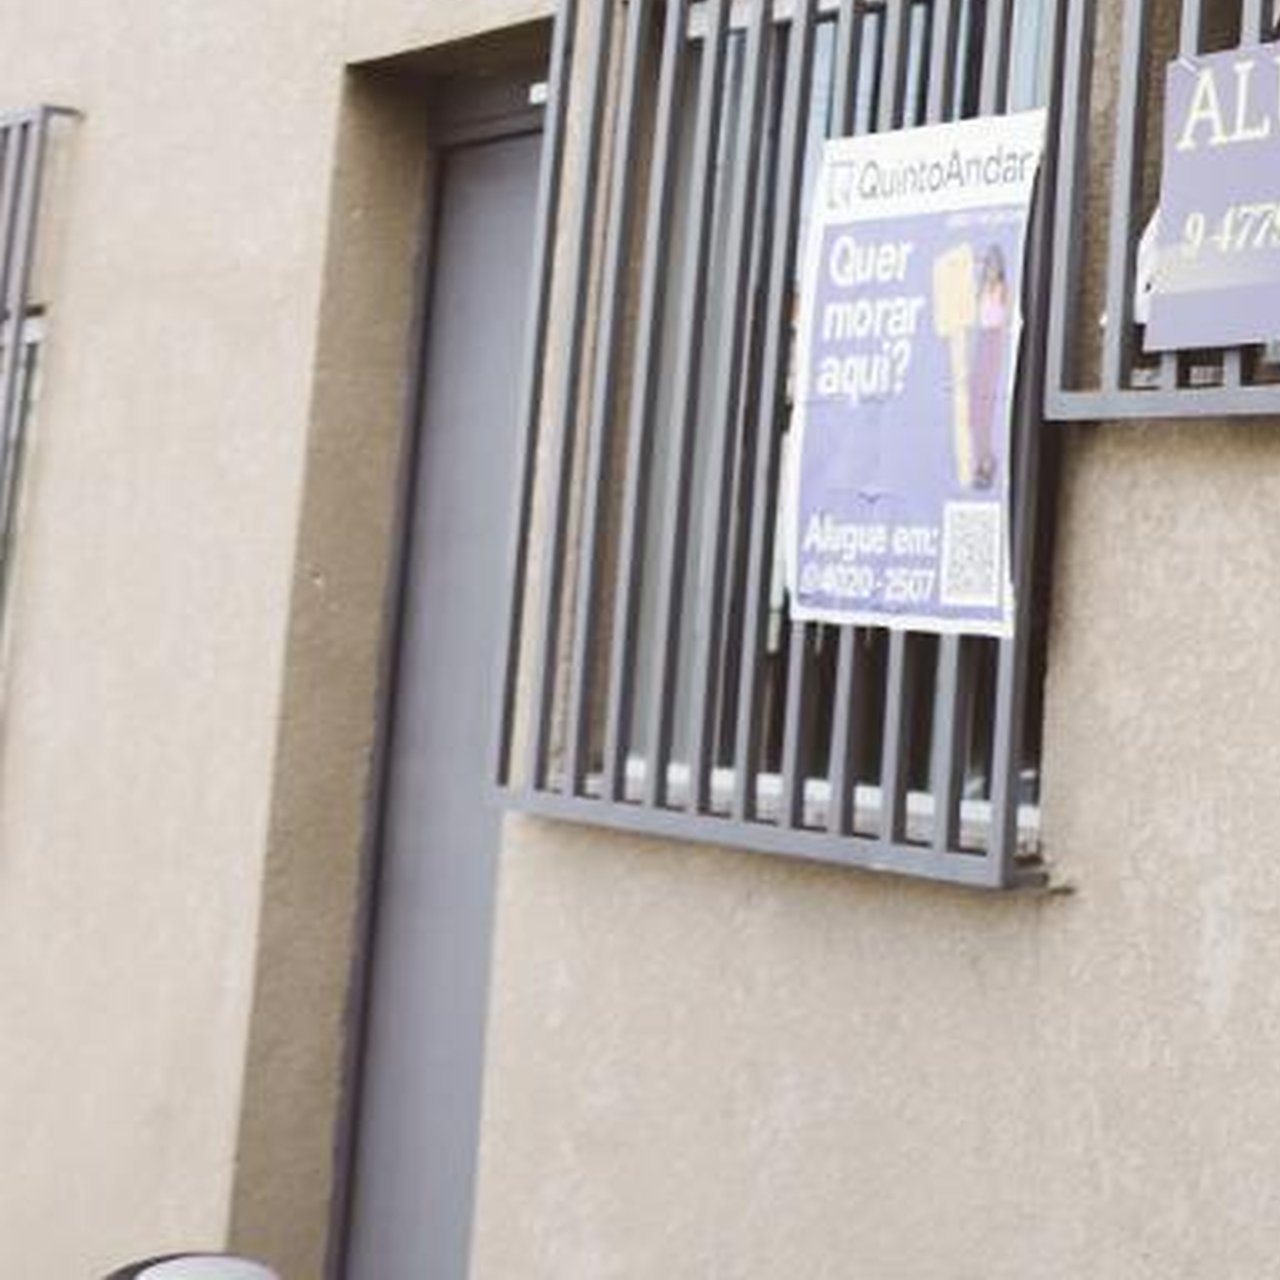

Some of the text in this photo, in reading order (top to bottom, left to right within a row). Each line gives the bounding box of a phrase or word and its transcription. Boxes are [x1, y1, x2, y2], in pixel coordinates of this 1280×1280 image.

[857, 144, 1034, 200] QuintoAndar
[1183, 211, 1206, 258] 9
[828, 235, 913, 288] Quer
[822, 296, 926, 342] morar
[815, 340, 912, 406] aqui?
[801, 512, 887, 562] Alugue
